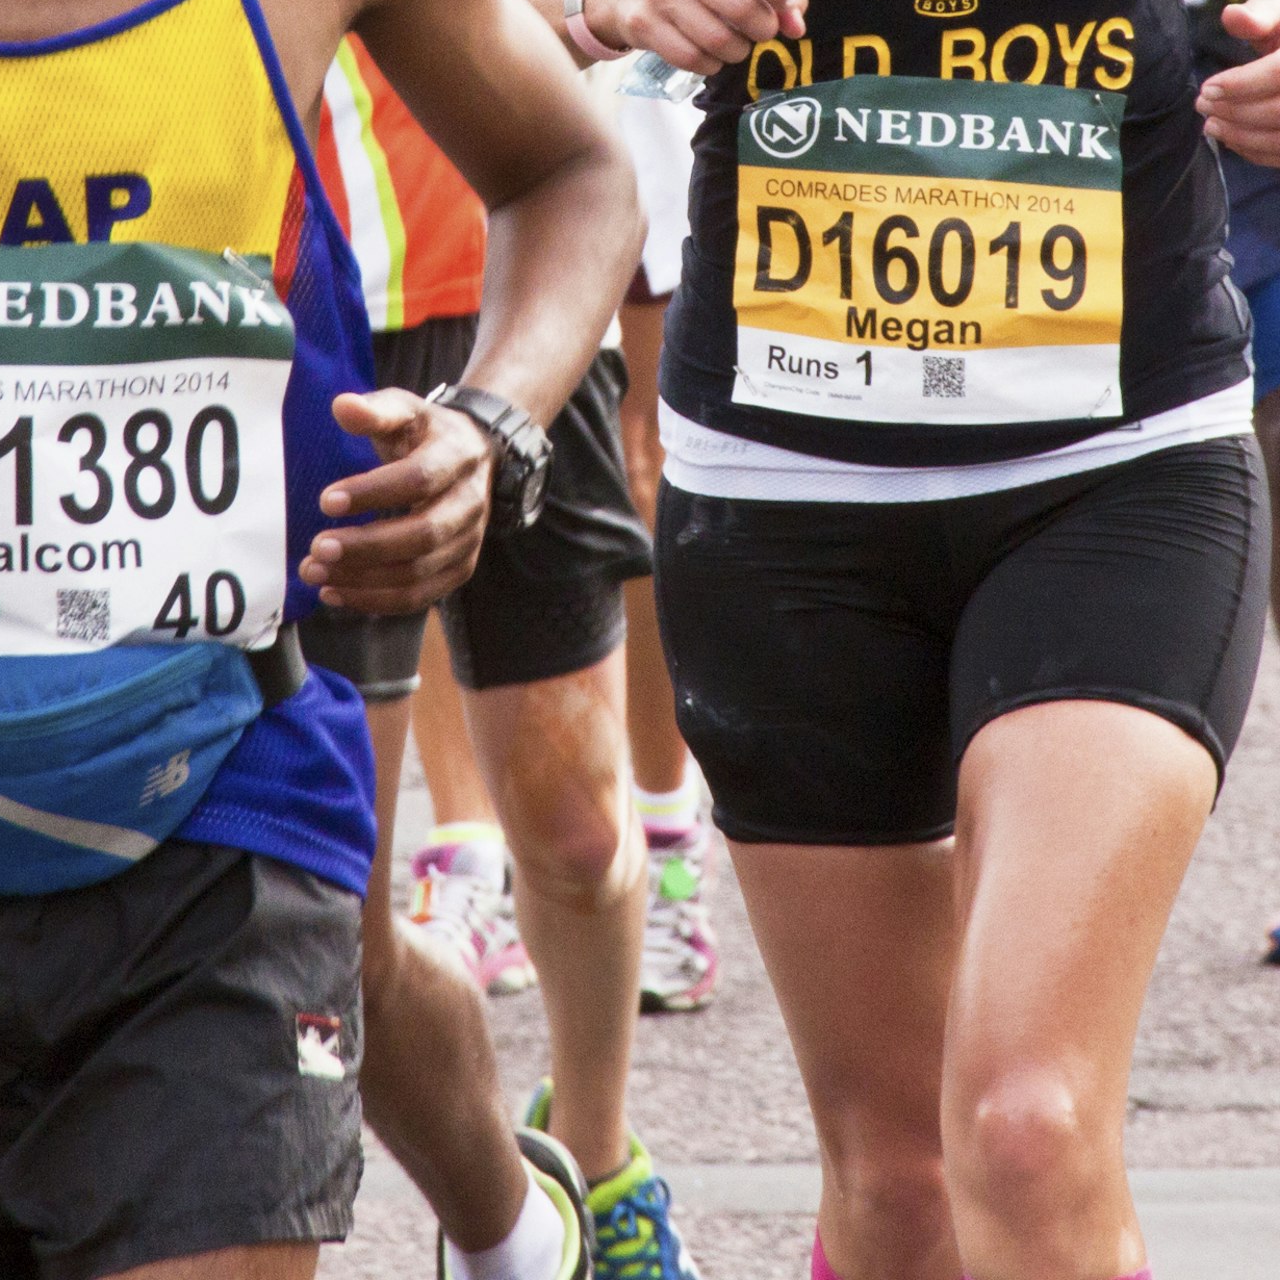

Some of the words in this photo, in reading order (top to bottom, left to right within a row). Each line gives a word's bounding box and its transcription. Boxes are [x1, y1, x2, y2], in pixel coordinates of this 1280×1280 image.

[940, 17, 1136, 91] BOYS
[834, 106, 1114, 161] NEDBANK
[765, 178, 888, 204] COMRADES
[895, 185, 1020, 212] MARATHON
[1027, 194, 1076, 216] 2014
[753, 205, 1088, 312] D16019
[845, 306, 983, 352] Megan
[17, 377, 166, 403] MARATHON
[173, 370, 231, 395] 2014
[767, 345, 840, 381] Runs
[855, 350, 873, 387] 1
[153, 569, 247, 639] 40
